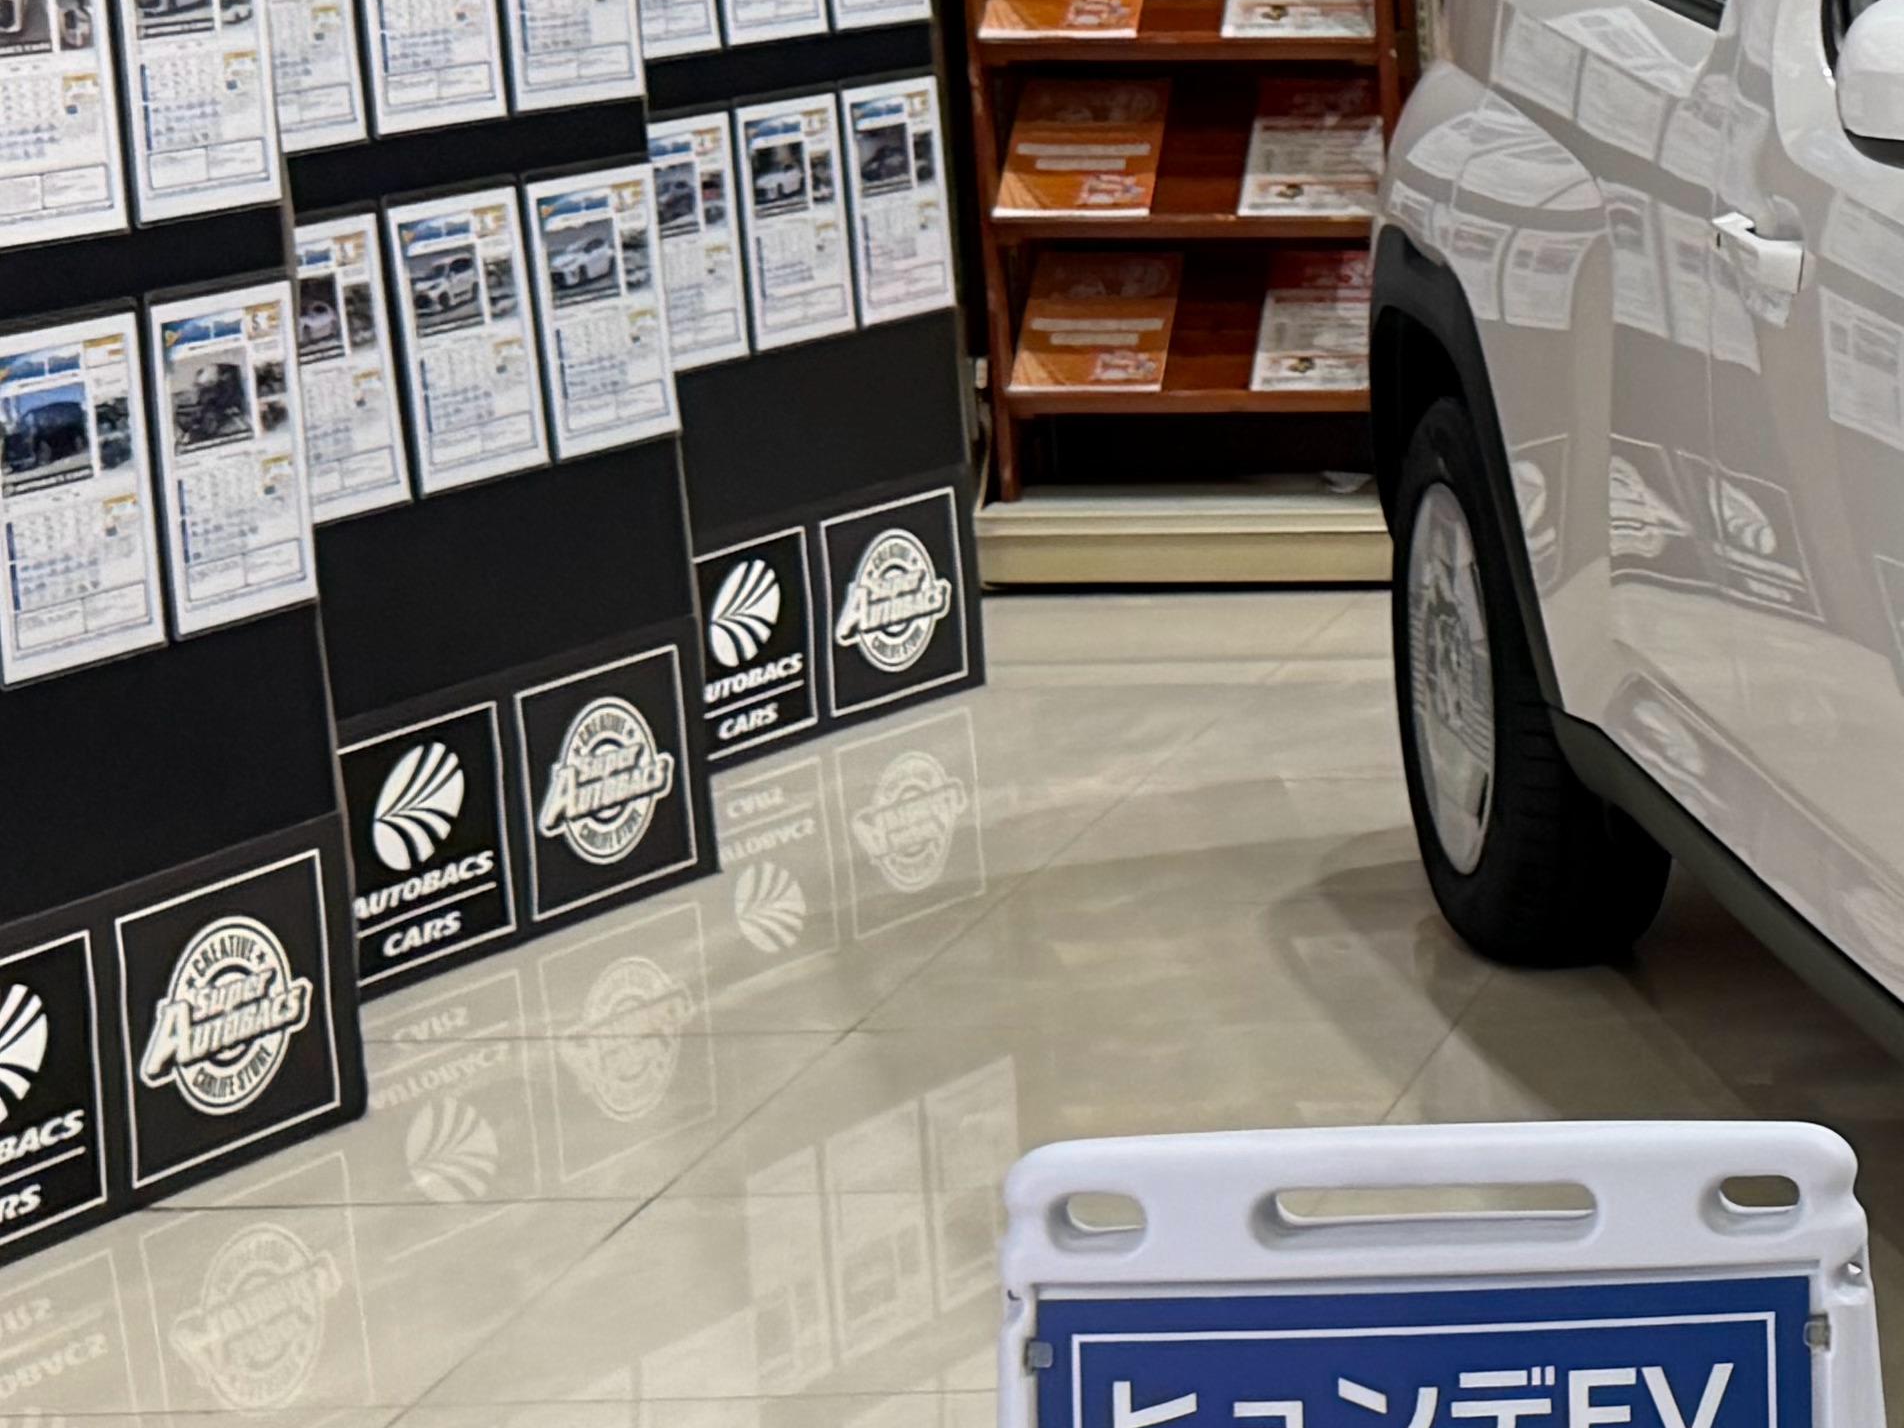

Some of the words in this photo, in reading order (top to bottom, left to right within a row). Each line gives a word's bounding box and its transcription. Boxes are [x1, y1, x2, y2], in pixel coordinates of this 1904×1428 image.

[703, 652, 803, 703] UTOBACS
[718, 702, 778, 740] CARS
[353, 850, 494, 919] AUTOBACS
[192, 933, 256, 971] CREATIVE
[383, 912, 461, 957] CARS
